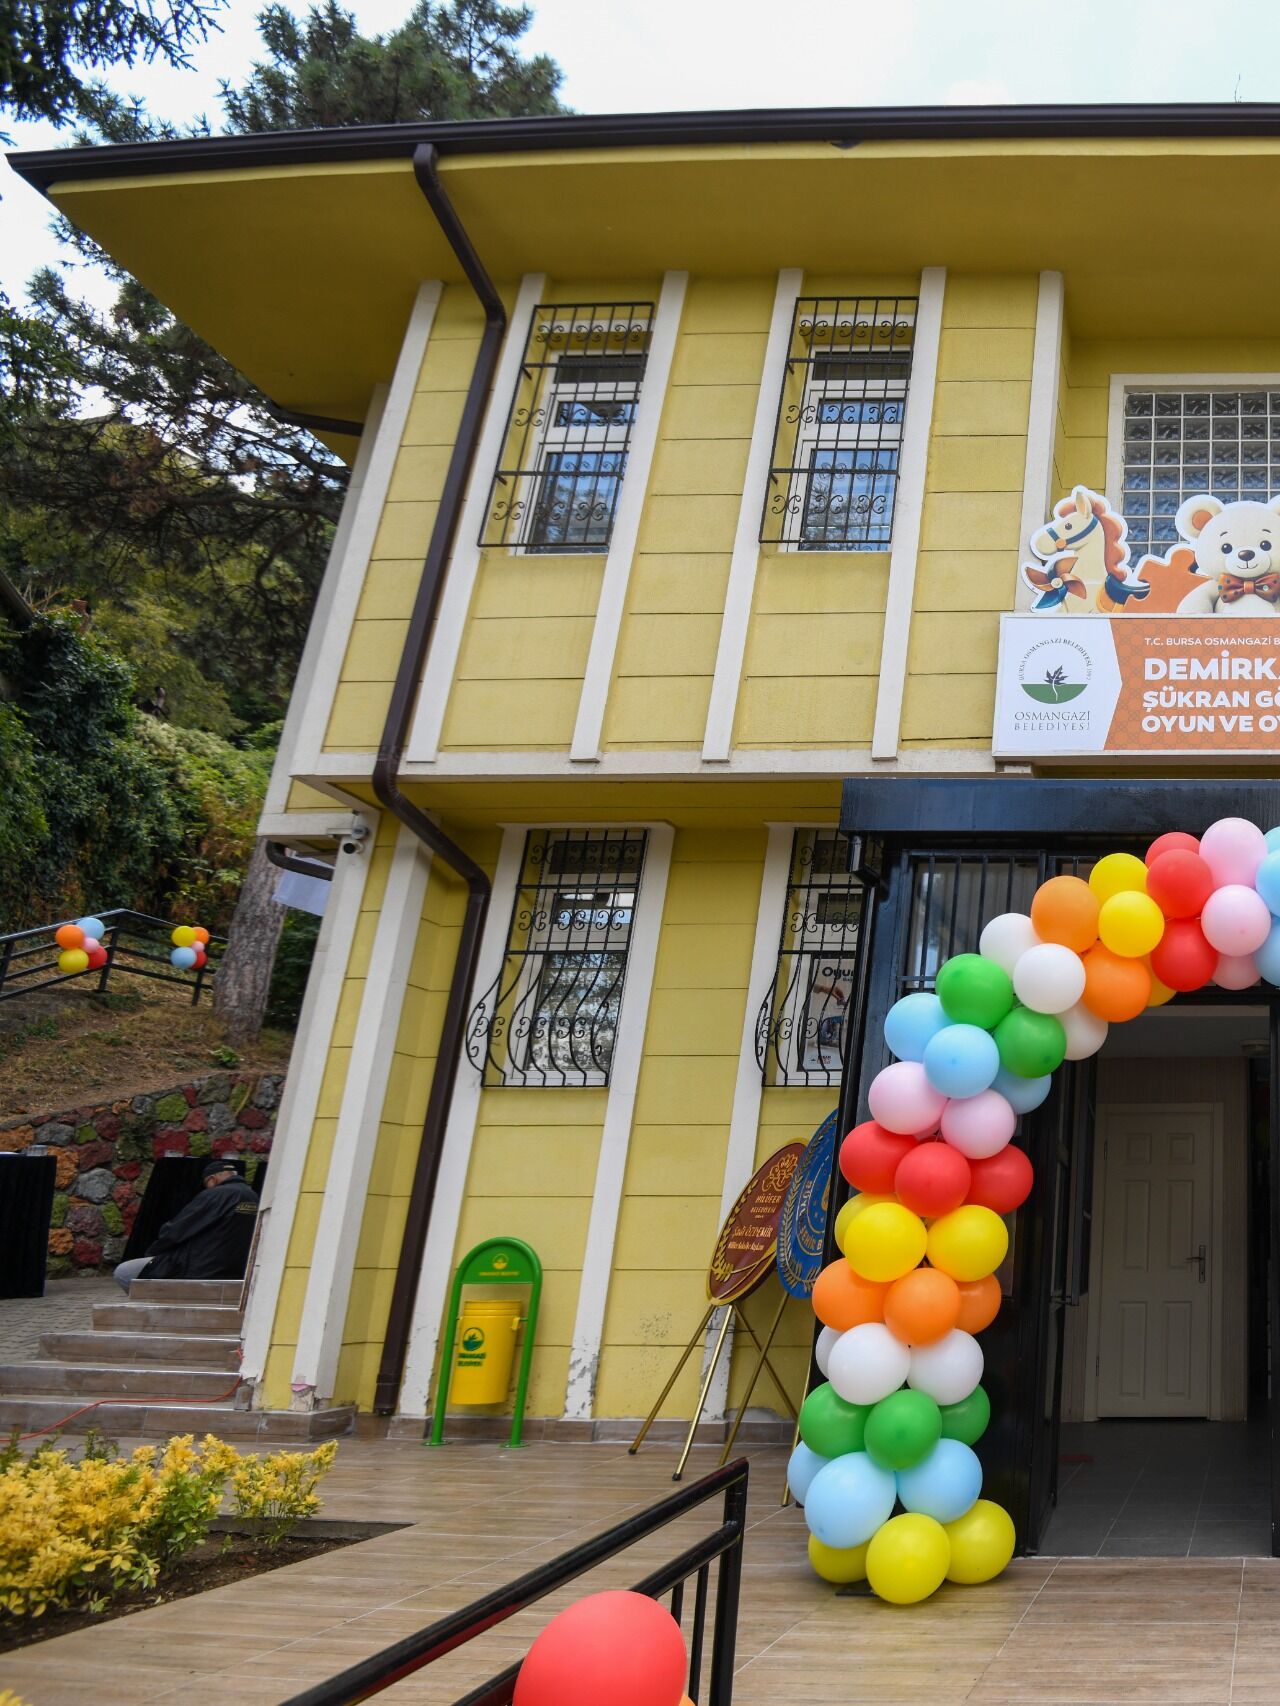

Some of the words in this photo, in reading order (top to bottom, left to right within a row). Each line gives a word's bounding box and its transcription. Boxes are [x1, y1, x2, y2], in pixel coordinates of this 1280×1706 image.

[1145, 637, 1164, 646] T.C.
[1166, 637, 1202, 646] BURSA
[1204, 635, 1271, 646] OSMANGAZİ
[1142, 685, 1250, 713] ŞÜKRAN
[1014, 711, 1091, 721] OSMANGAZİ
[1014, 722, 1090, 731] BELEDİYESİ
[1141, 714, 1215, 733] OYUN
[1219, 715, 1254, 733] VE
